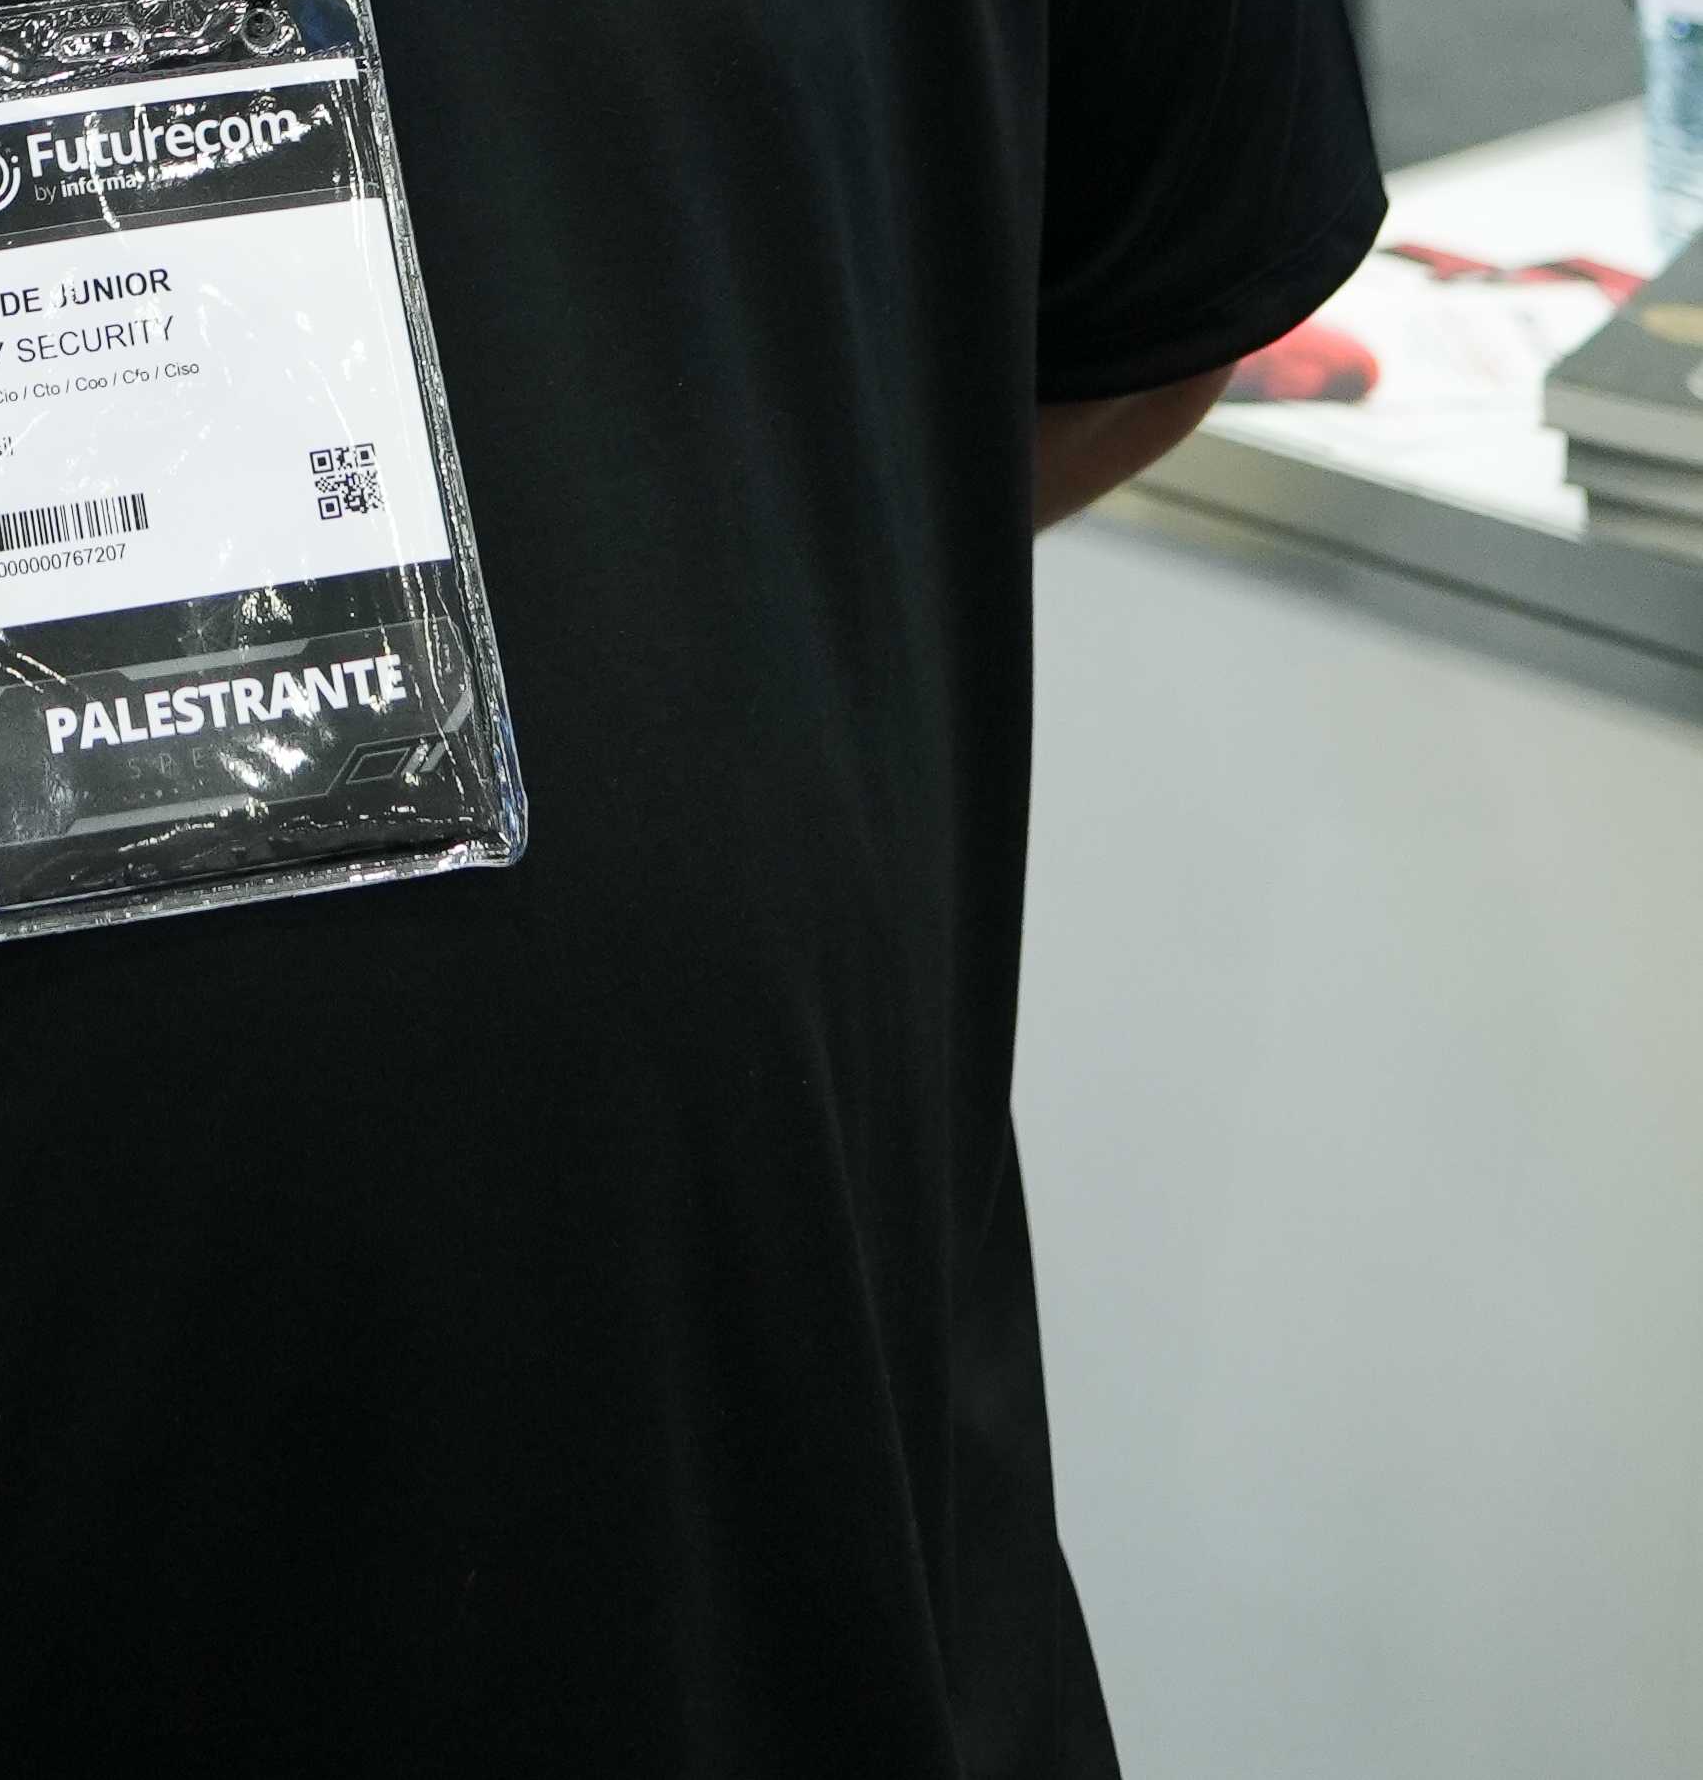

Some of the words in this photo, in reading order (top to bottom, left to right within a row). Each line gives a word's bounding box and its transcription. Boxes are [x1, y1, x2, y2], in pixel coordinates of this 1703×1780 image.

[27, 109, 301, 178] Futurecom
[34, 185, 58, 204] by
[59, 268, 172, 309] JUNIOR
[16, 315, 174, 363] SECURITY
[33, 383, 61, 399] Cto
[75, 375, 108, 391] Coo
[164, 361, 200, 379] Ciso
[45, 653, 408, 755] PALESTRANTE
